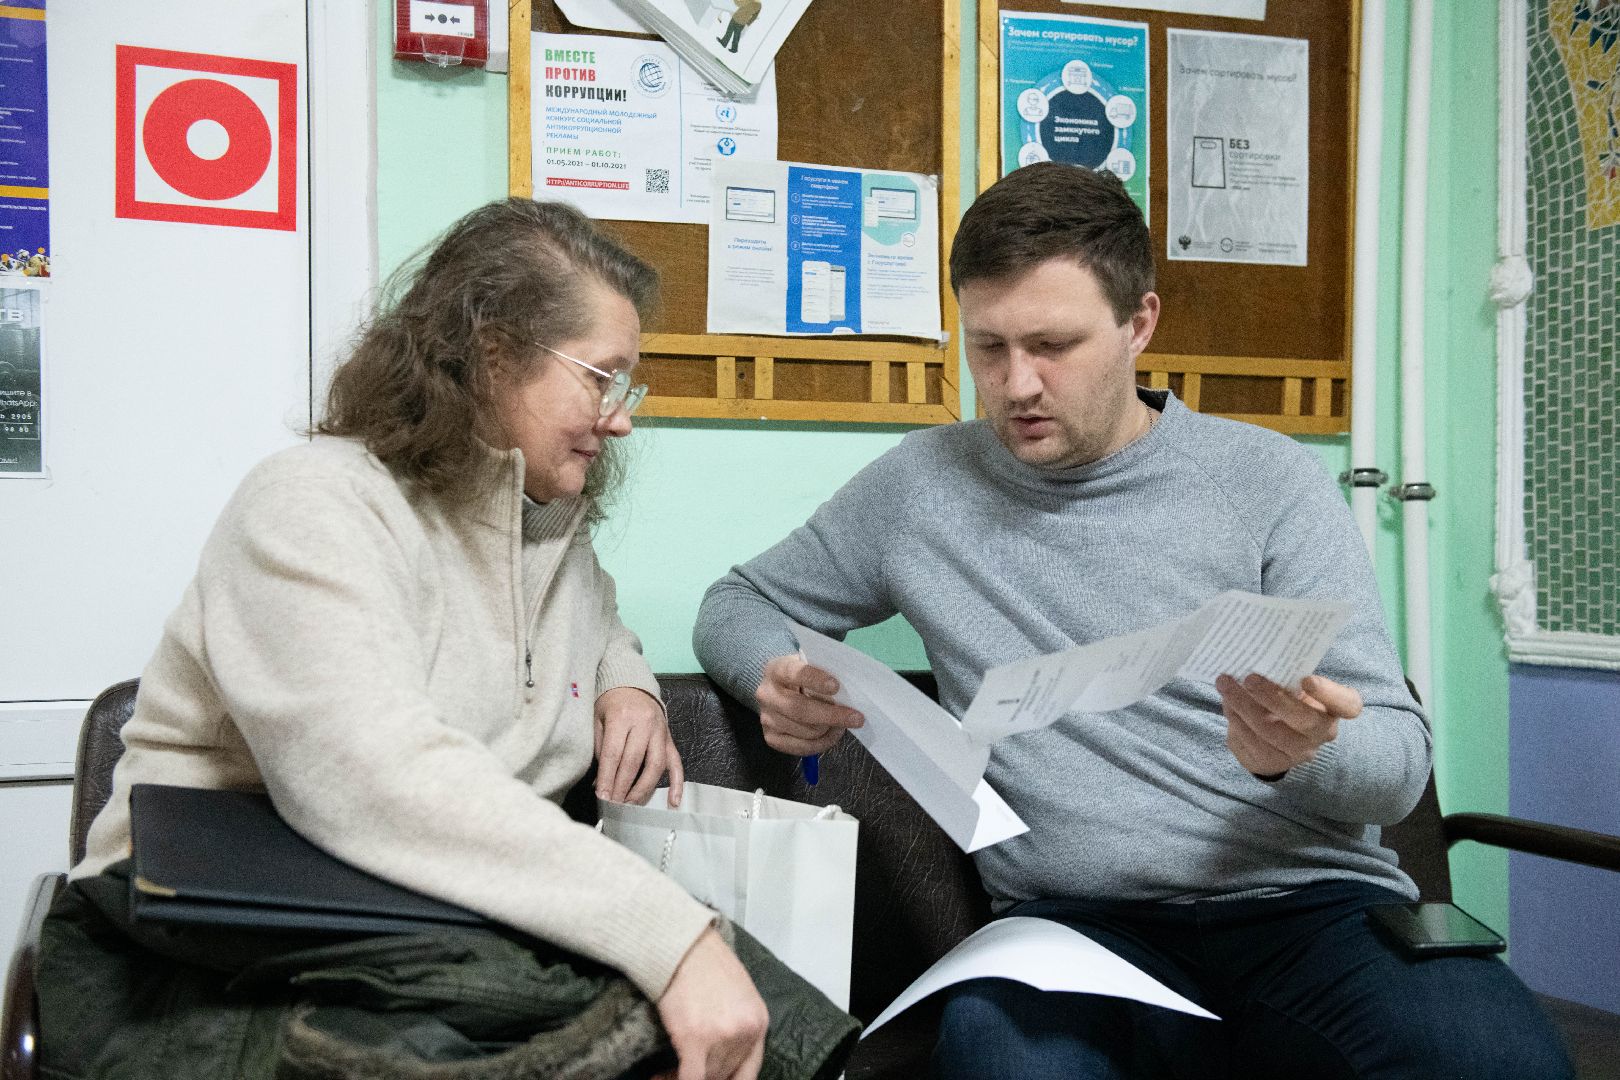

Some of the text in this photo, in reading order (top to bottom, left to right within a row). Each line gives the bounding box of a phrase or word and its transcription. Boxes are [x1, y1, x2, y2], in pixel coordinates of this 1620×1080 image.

[1008, 26, 1138, 47] Зачем сортировать мусор?
[545, 48, 596, 63] ВМЕСТЕ
[545, 67, 596, 81] ПРОТИВ
[545, 85, 627, 102] КОРРУПЦИИ!
[545, 106, 657, 119] МЕЖДУНАРОДНЫЙ МОЛОДЕЖНЫЙ
[545, 114, 622, 126] КОНКУРС СОЦИАЛЬНОЙ
[1054, 116, 1099, 126] Экономика
[545, 123, 622, 134] АНТИКОРРУПЦИОННОЙ
[1054, 126, 1100, 135] замкнутого
[546, 131, 579, 140] РЕКЛАМЫ
[1229, 138, 1250, 150] БЕЗ
[546, 146, 621, 158] ПРИЕМ РАБОТ:
[546, 158, 584, 167] 01.05.2021
[591, 161, 627, 170] 01.10.2021
[0, 399, 38, 408] hatsApp:
